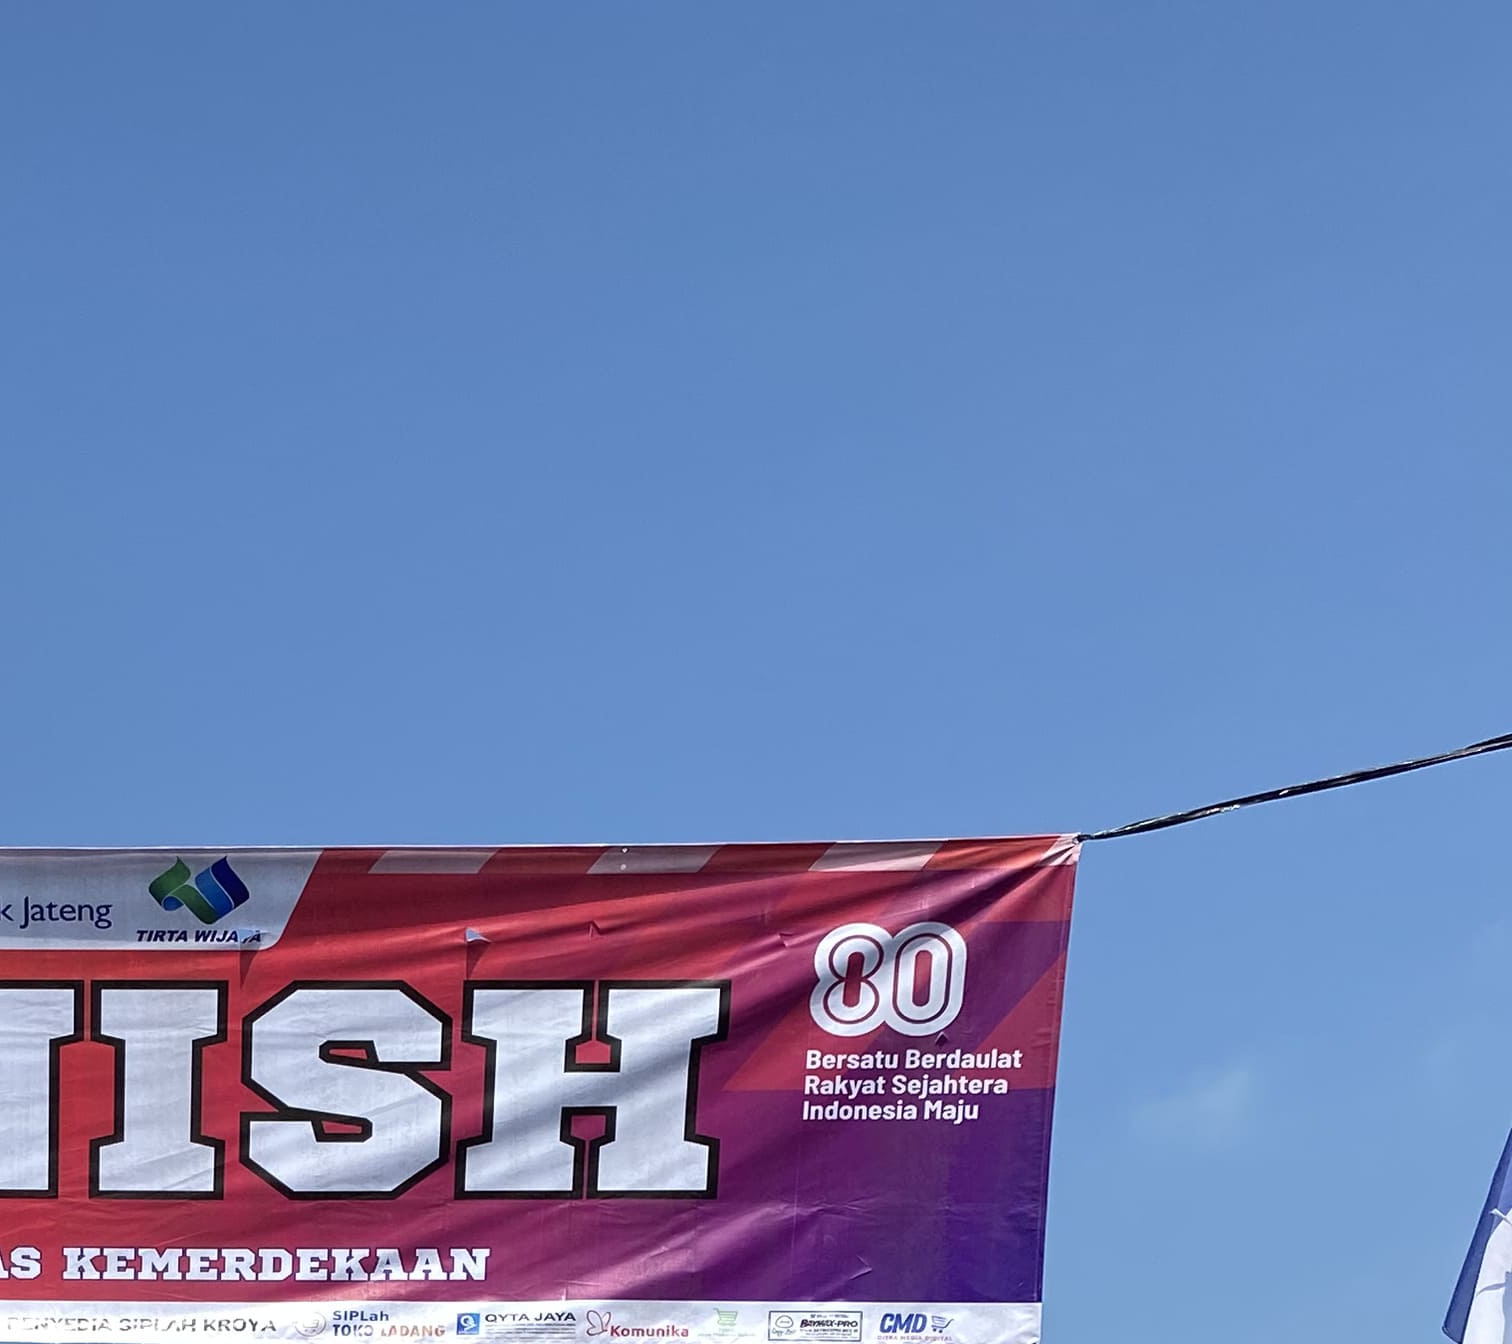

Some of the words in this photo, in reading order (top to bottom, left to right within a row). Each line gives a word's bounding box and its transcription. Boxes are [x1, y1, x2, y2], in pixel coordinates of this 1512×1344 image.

[20, 896, 113, 930] Jateng
[136, 930, 188, 942] TIRTA
[194, 929, 261, 943] WIJAA
[809, 922, 967, 1036] 80
[806, 1049, 899, 1070] Bersatu
[905, 1049, 1023, 1070] Berdaulat
[804, 1075, 886, 1099] Rakyat
[892, 1075, 1008, 1099] Sejahtera
[802, 1101, 918, 1120] Indonesia
[923, 1100, 980, 1125] Maju
[61, 1245, 491, 1283] KEMERDEKAAN
[203, 1318, 278, 1333] KROYA
[332, 1310, 389, 1322] SIPLah
[534, 1312, 577, 1322] JAYA
[879, 1313, 927, 1334] CMD
[610, 1324, 689, 1338] Komunika
